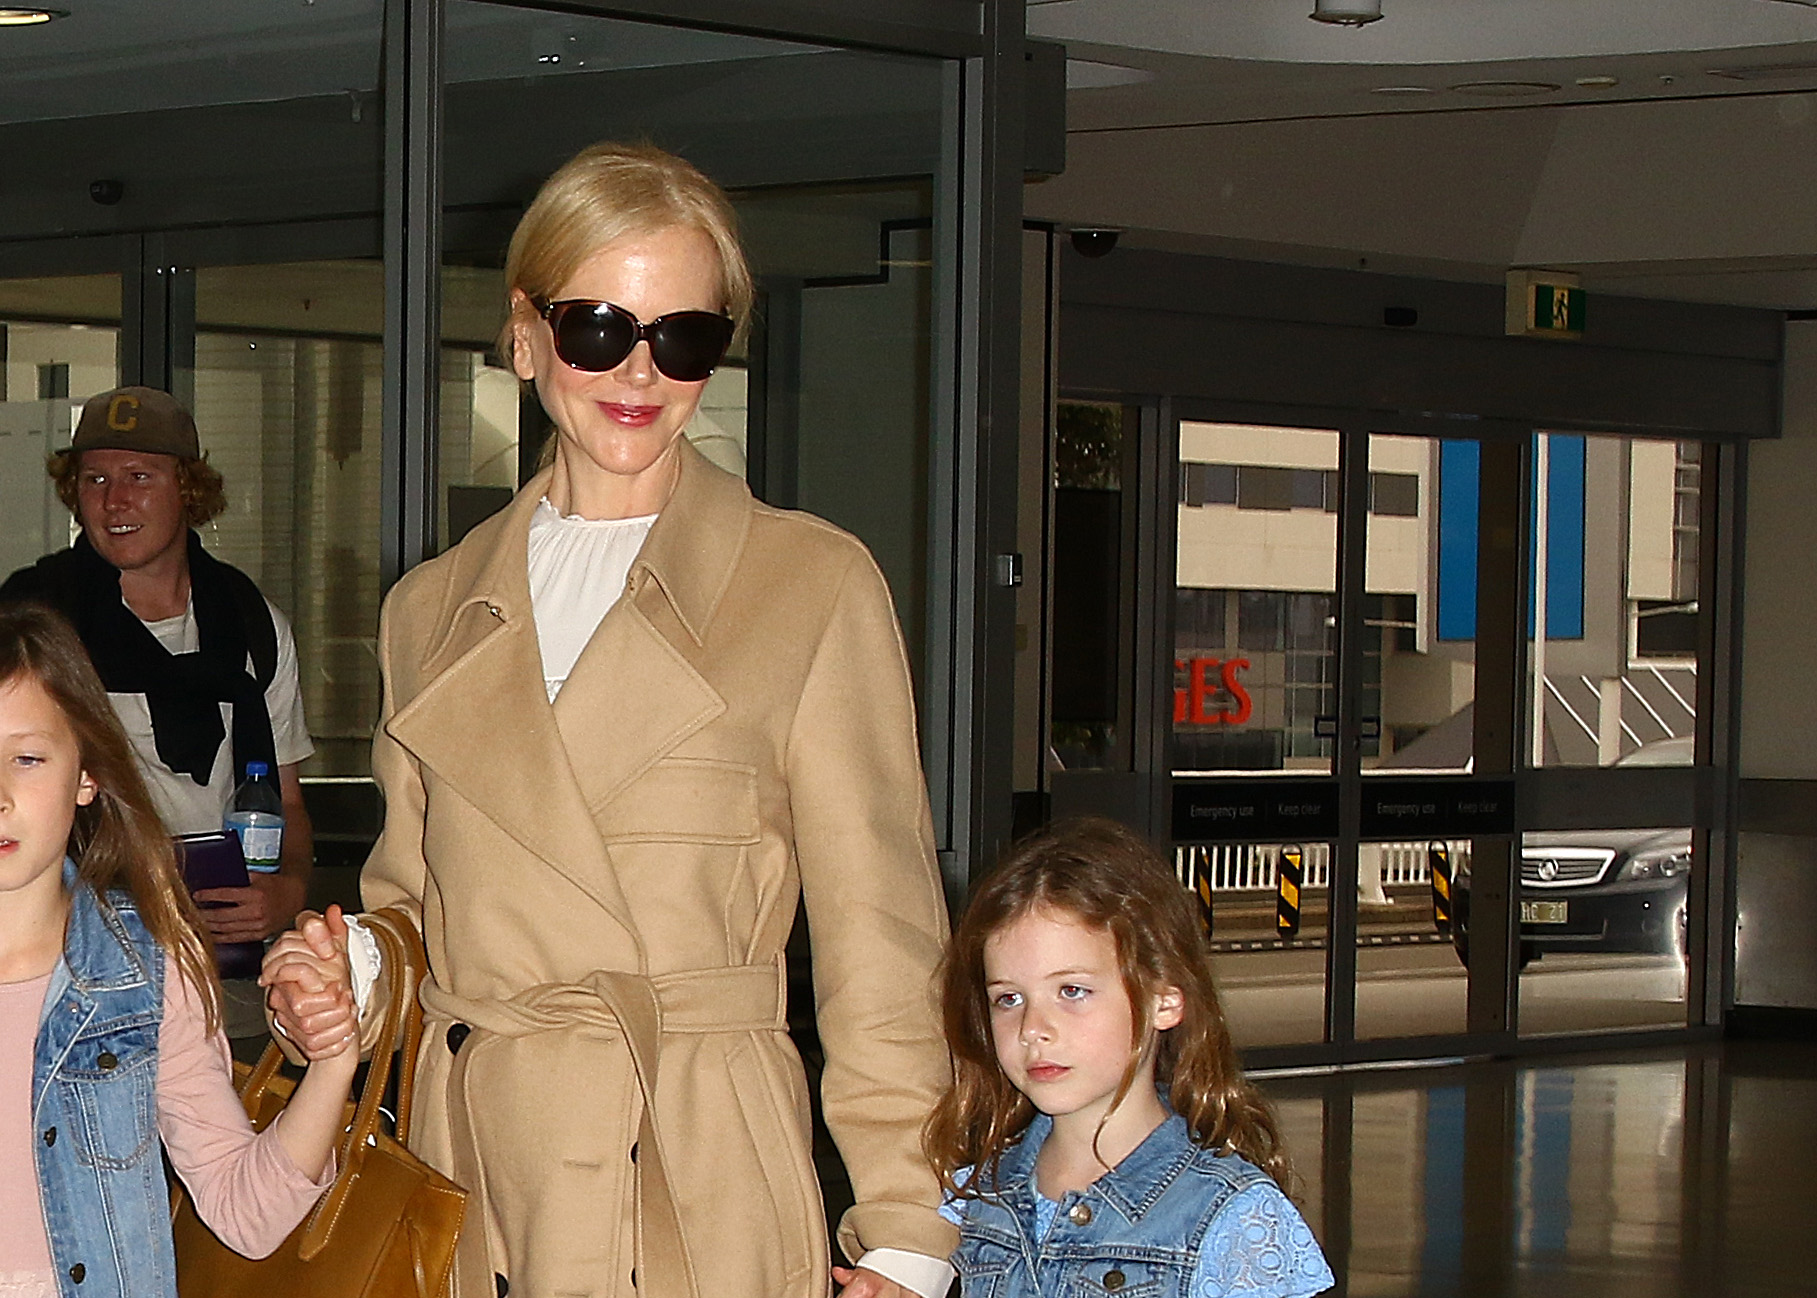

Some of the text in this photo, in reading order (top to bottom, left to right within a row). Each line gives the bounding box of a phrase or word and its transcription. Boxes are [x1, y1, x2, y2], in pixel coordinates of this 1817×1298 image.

[107, 394, 141, 432] C
[1190, 803, 1321, 820] Emergency use Keep clear
[1377, 802, 1419, 818] Emergency
[1422, 803, 1436, 815] use
[1456, 801, 1478, 816] Keep
